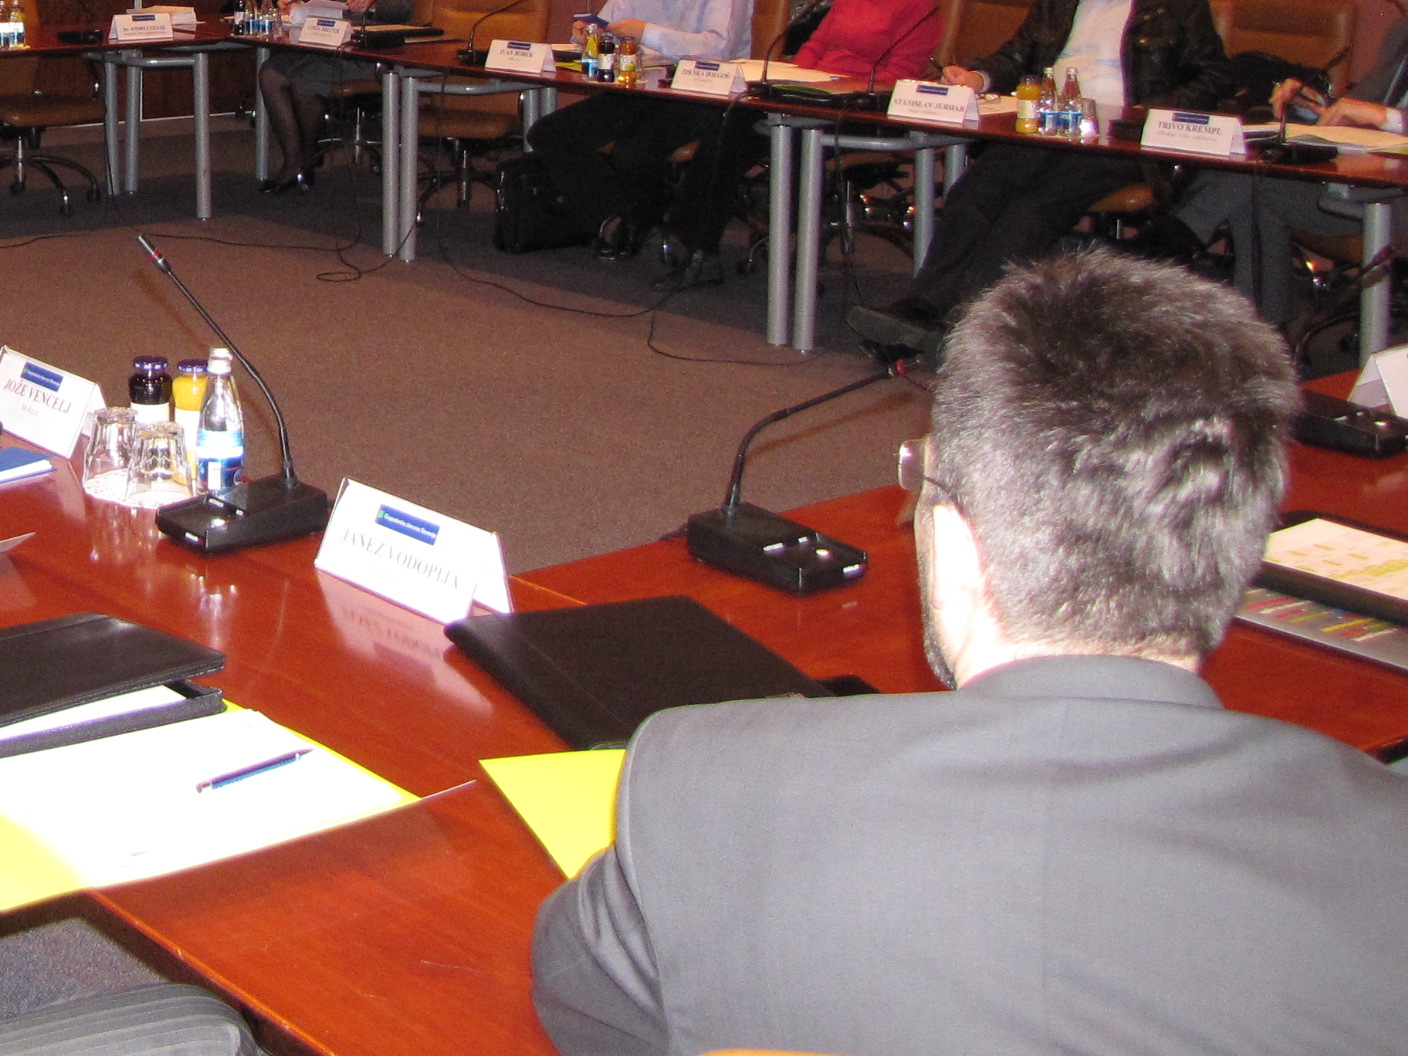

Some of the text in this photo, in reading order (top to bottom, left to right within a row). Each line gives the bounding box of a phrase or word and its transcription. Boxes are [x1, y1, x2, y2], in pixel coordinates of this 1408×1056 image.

[3, 378, 28, 397] JOŽE
[28, 387, 72, 414] VENCELJ
[341, 529, 385, 556] JANEZ
